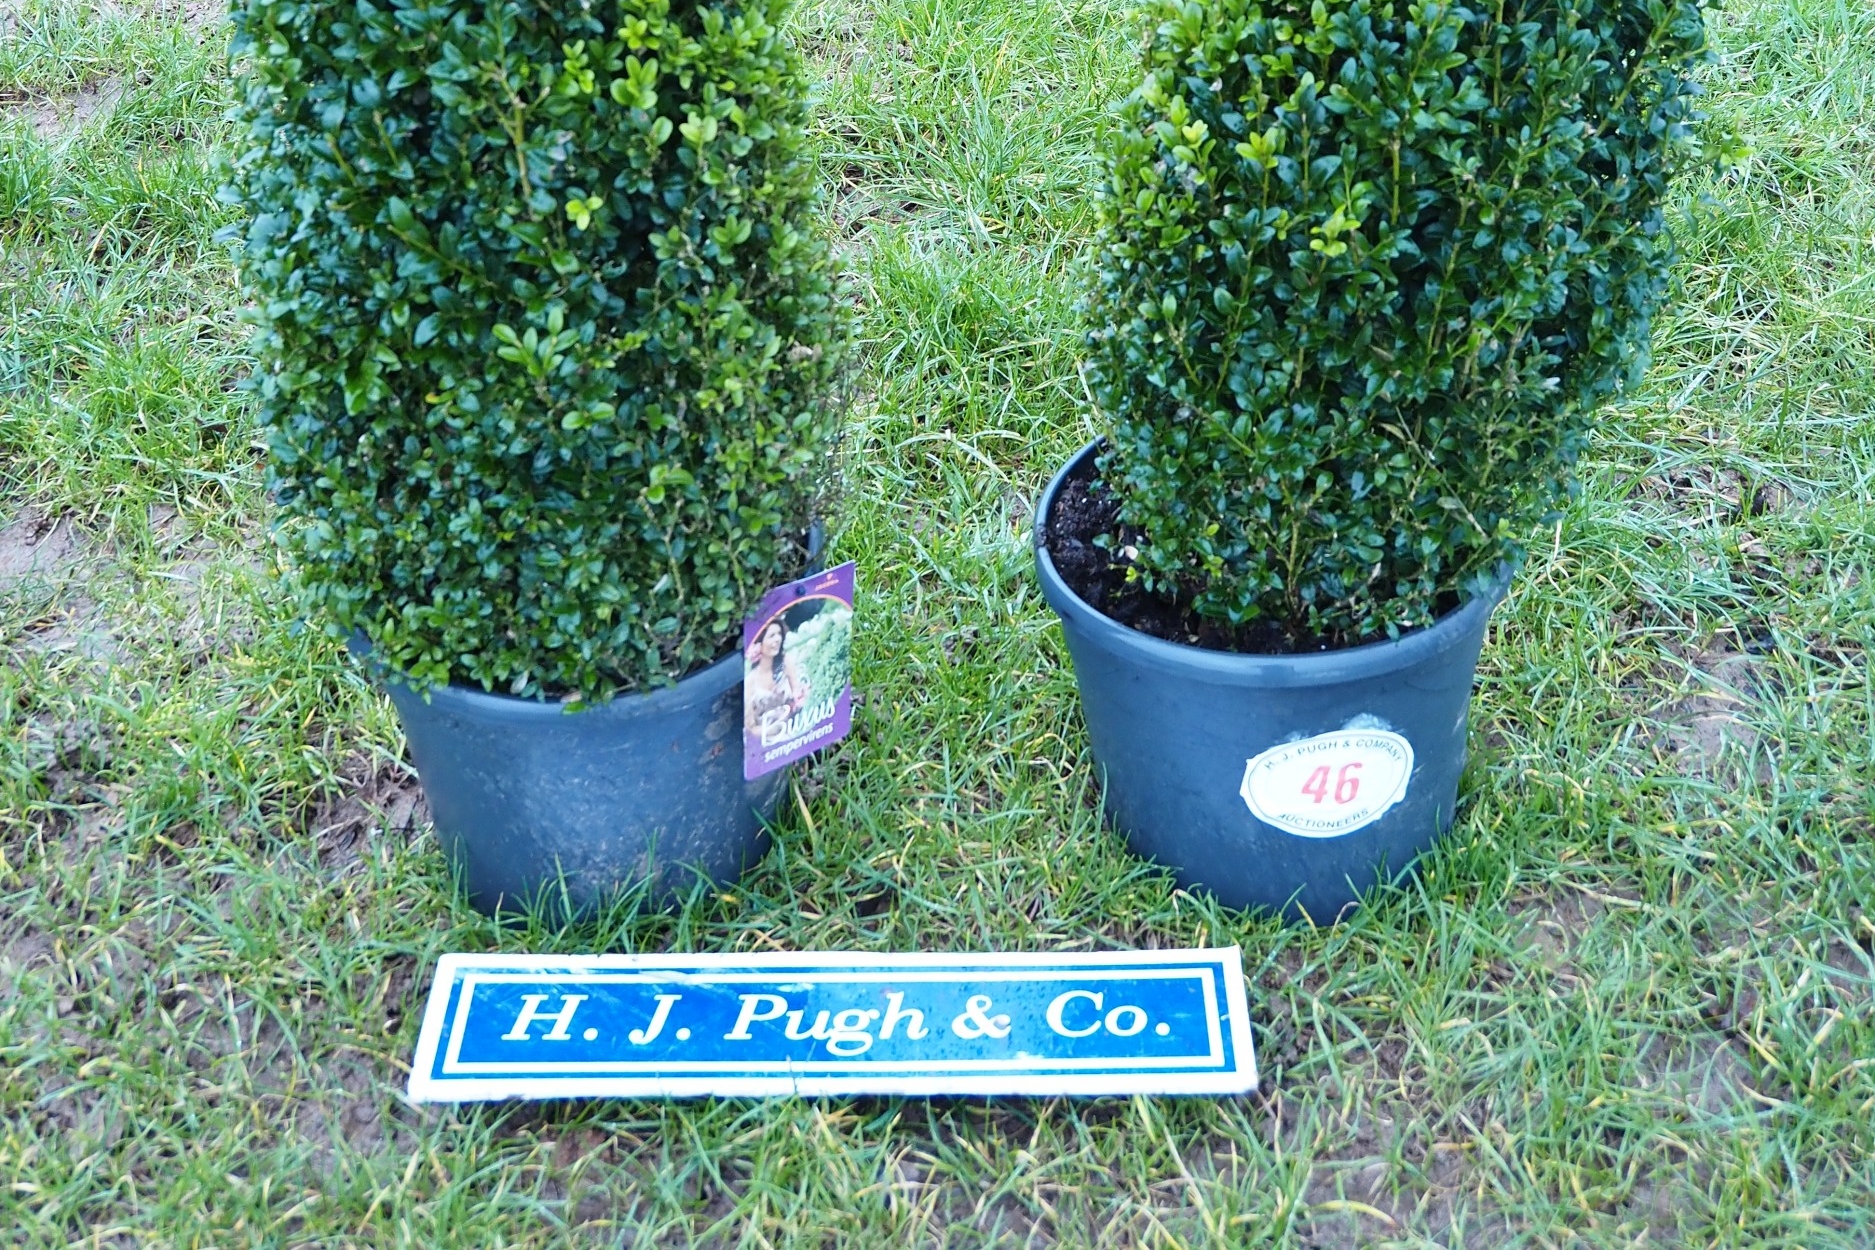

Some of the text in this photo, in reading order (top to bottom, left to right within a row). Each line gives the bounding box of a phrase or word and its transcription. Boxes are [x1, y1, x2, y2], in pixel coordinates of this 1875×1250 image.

[761, 697, 836, 748] Buxus
[764, 722, 834, 763] sempervirens
[1264, 738, 1403, 770] H. J. PUGH & COMPANY
[1301, 762, 1363, 805] 46
[1277, 808, 1369, 829] AUCTIONEERS
[501, 989, 1171, 1057] H. J. Pugh & Co.
